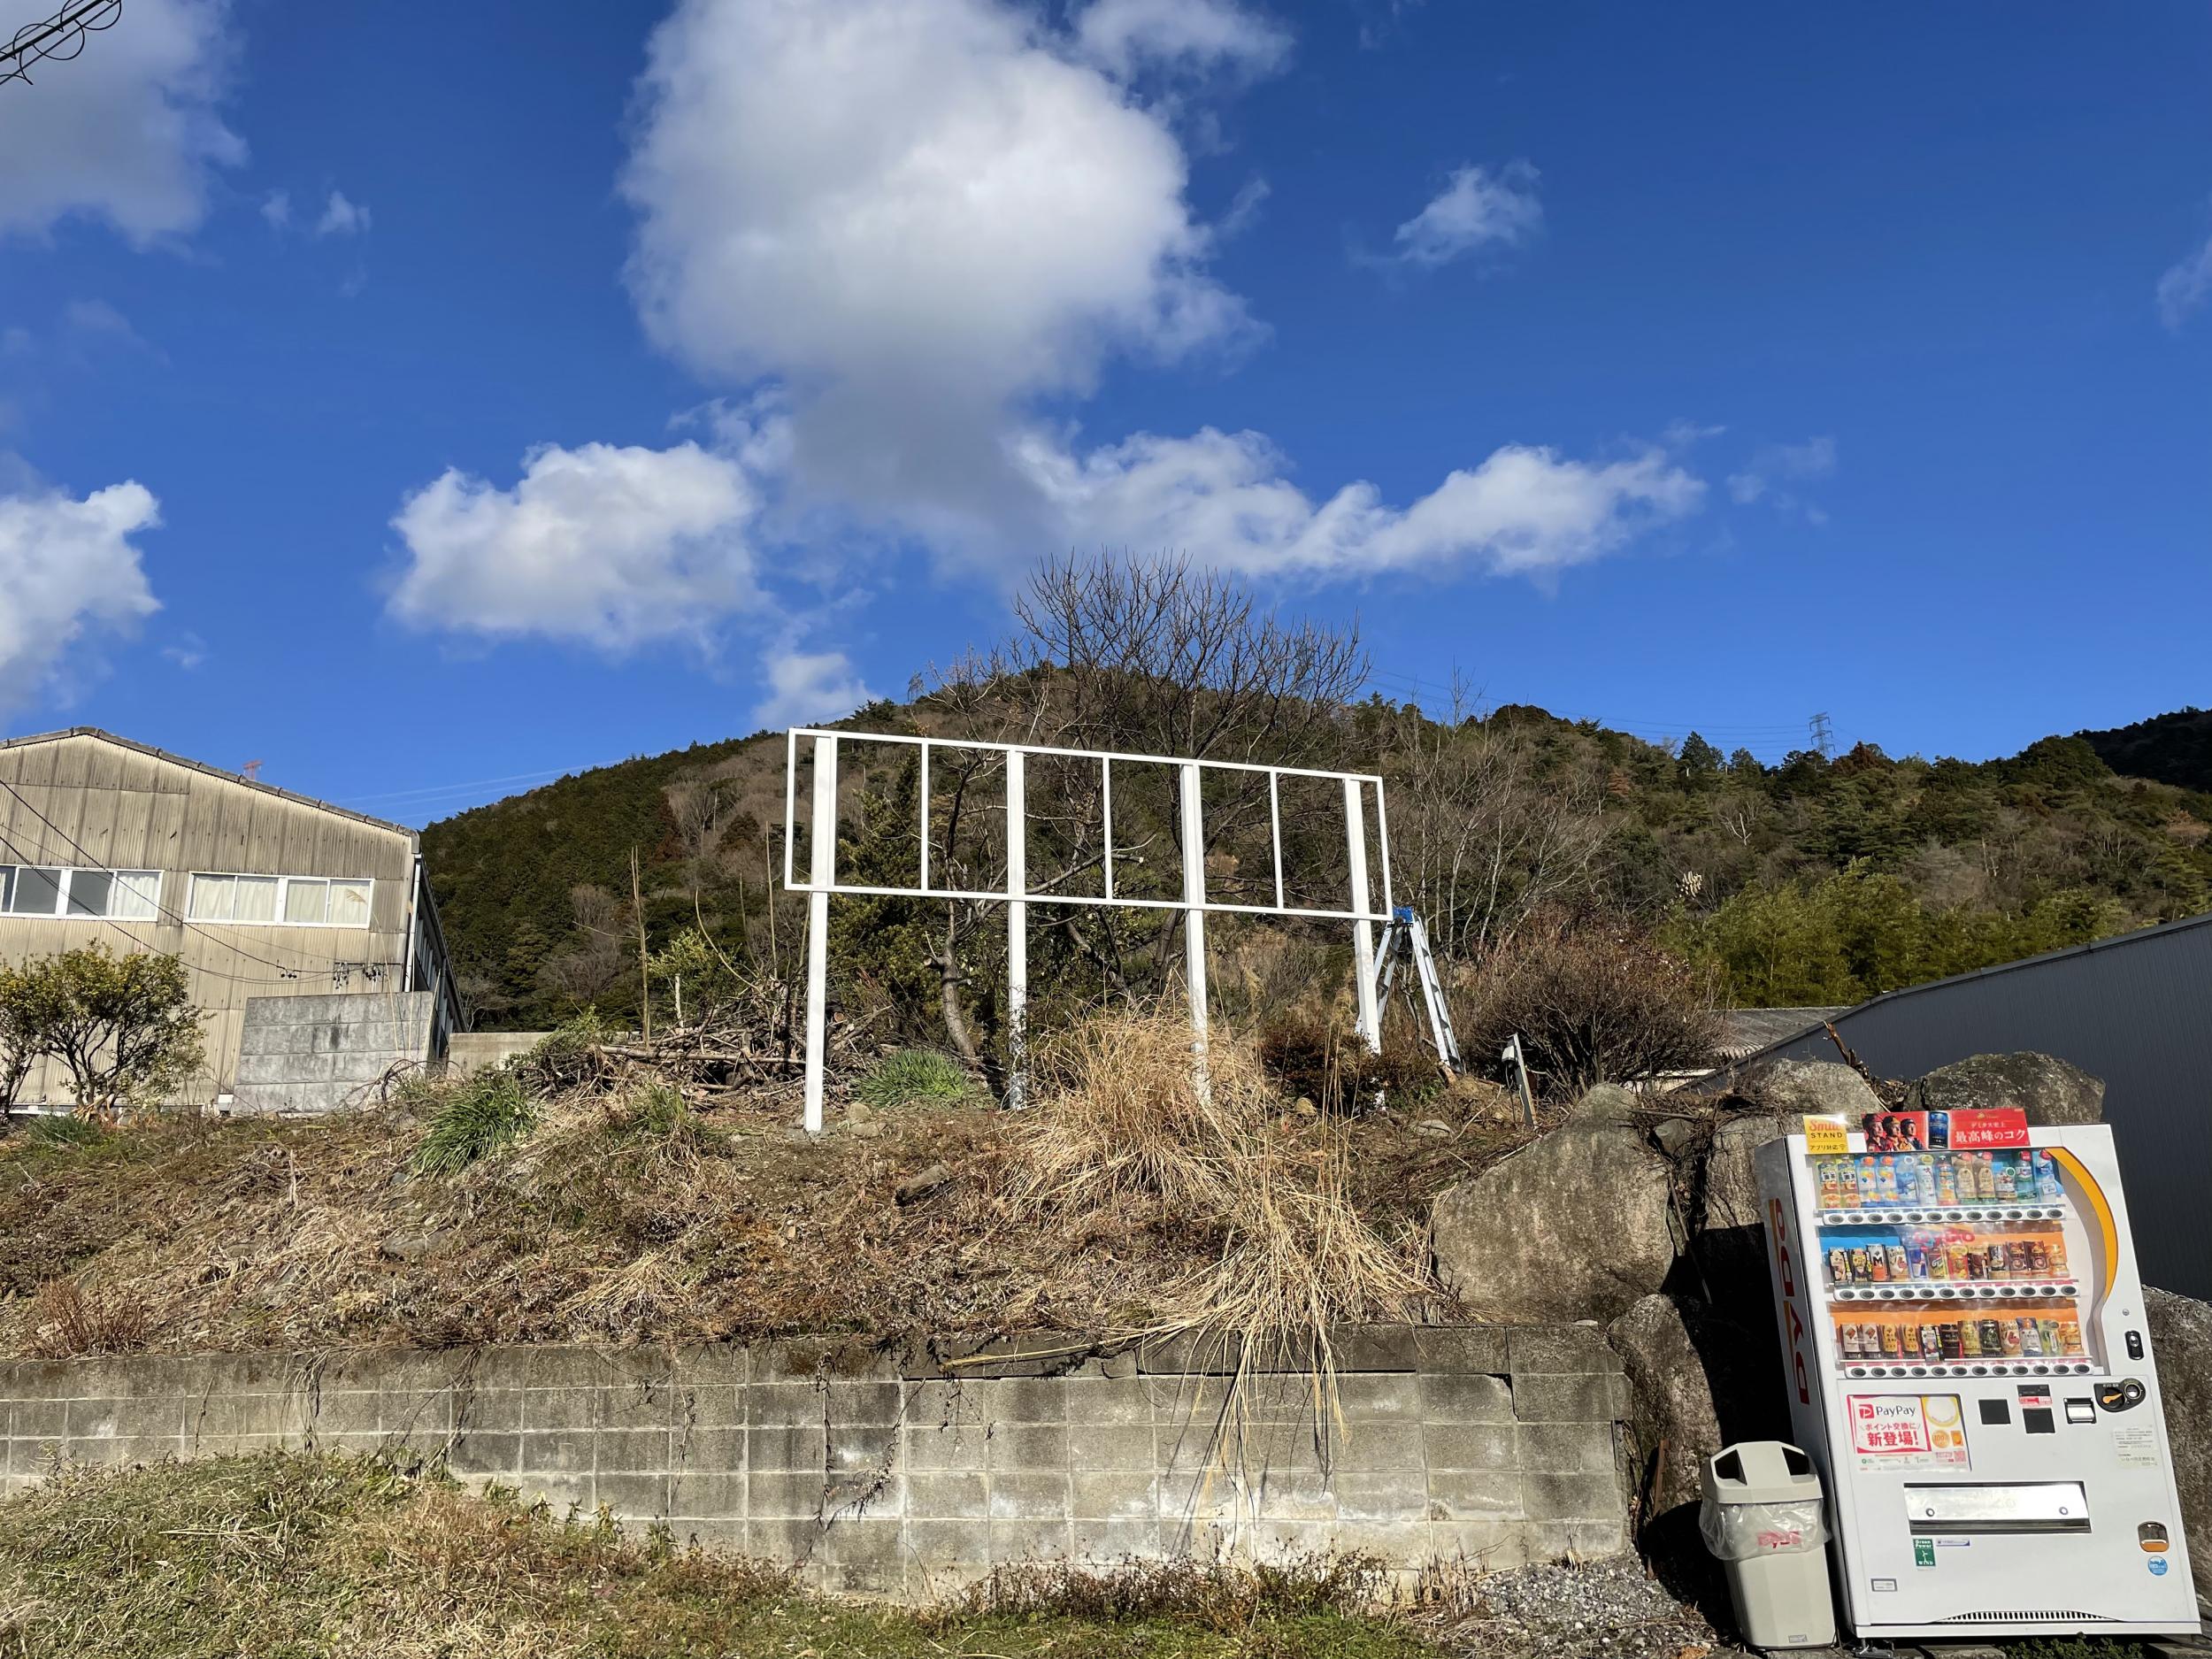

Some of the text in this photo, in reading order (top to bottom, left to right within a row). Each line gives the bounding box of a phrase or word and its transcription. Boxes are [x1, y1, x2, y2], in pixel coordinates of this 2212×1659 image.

[1955, 1129, 2025, 1143] 最高峰のコク
[1876, 1405, 1916, 1417] PayPay
[1865, 1422, 1916, 1431] ポイント交換に
[1867, 1431, 1919, 1447] 新登場!
